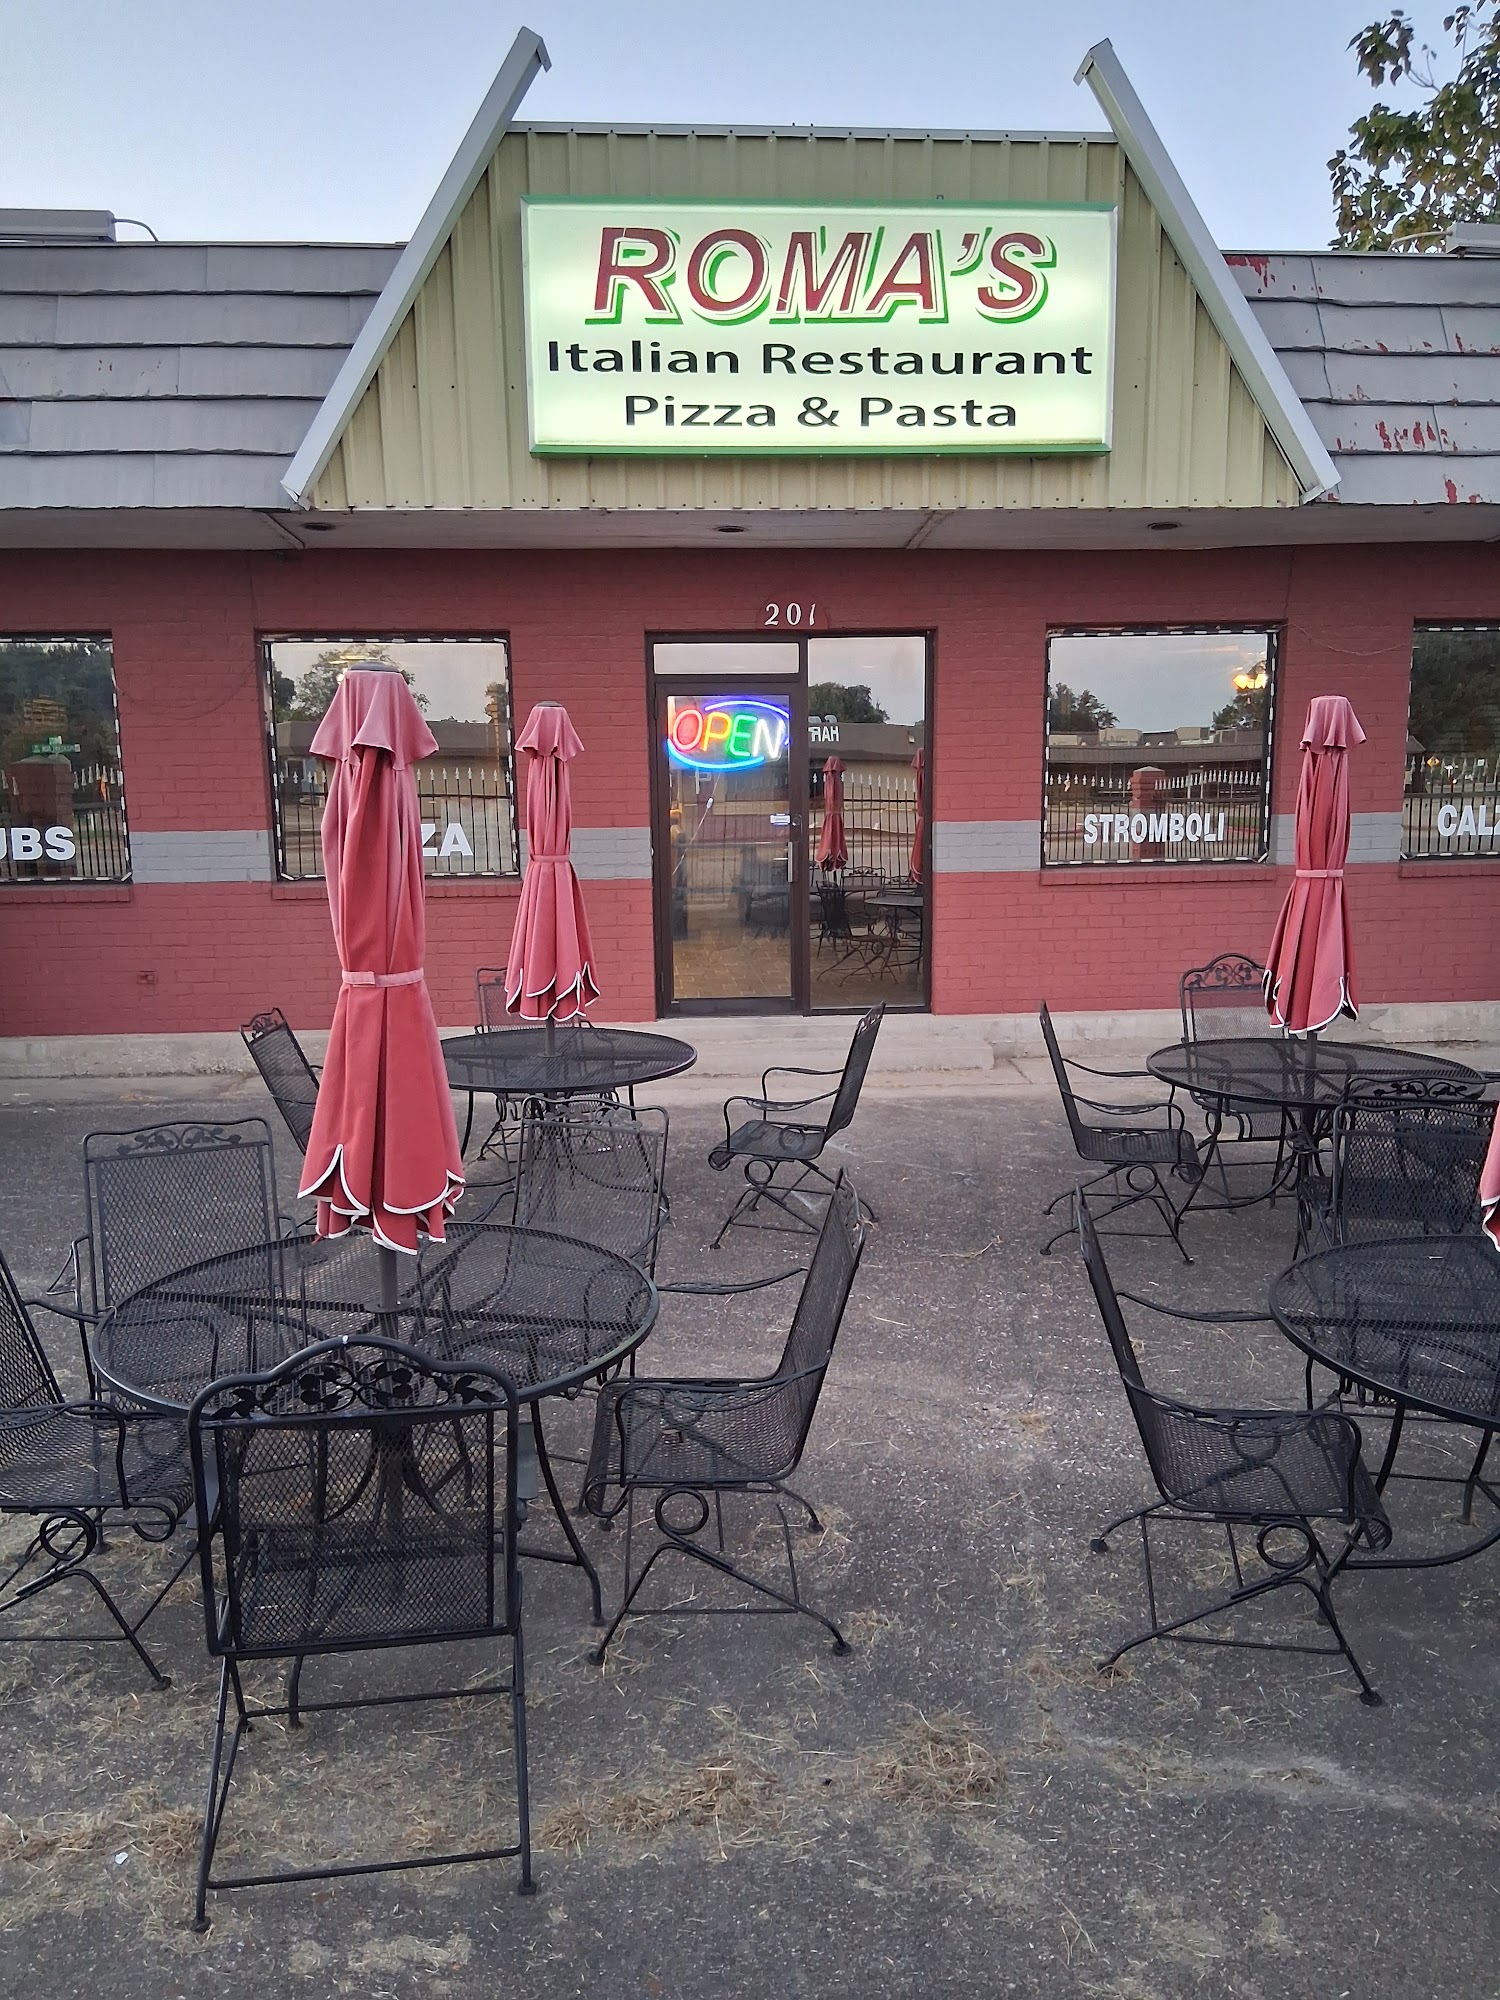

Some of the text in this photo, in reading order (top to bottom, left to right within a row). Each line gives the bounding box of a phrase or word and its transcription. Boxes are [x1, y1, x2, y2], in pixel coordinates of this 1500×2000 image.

[585, 225, 1057, 326] ROMA'S
[547, 340, 1093, 376] Italian Restaurant
[625, 395, 1017, 428] Pizza & Pasta
[764, 602, 816, 626] 201
[672, 708, 787, 760] OPEN
[0, 826, 76, 861] BS
[1083, 812, 1225, 844] STROMBOLI
